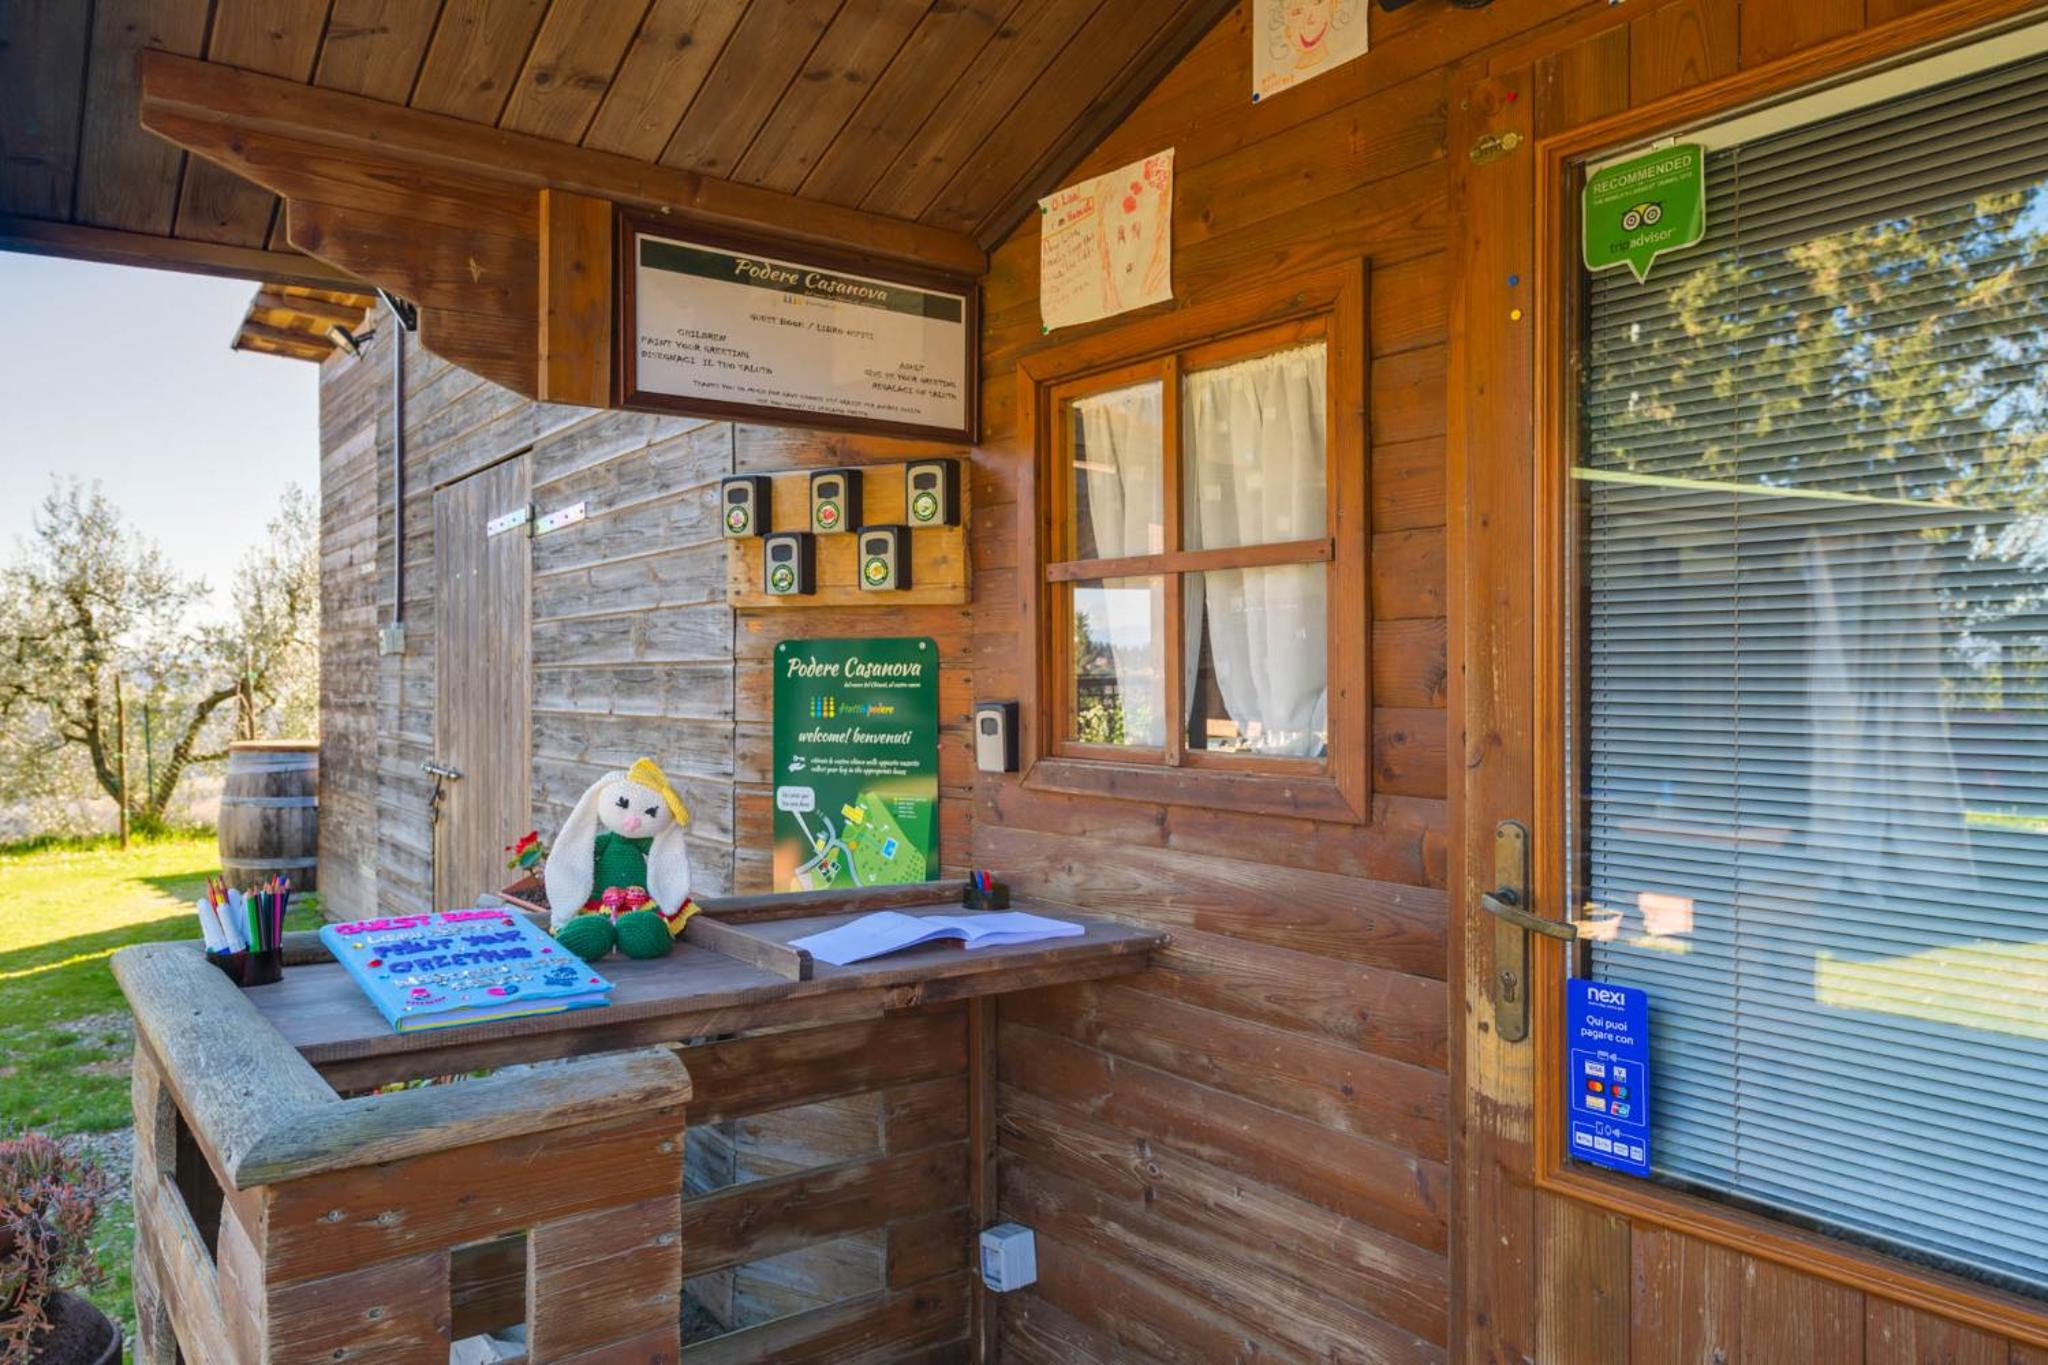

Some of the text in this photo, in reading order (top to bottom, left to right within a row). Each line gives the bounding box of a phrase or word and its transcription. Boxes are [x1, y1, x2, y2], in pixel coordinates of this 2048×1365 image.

[1593, 155, 1692, 195] RECOMMENDED
[1610, 228, 1673, 253] tripadvisor
[734, 258, 798, 285] Podere
[805, 272, 888, 301] Casanova
[780, 317, 803, 328] BOOK
[640, 335, 671, 346] PAINT
[675, 340, 701, 351] YOUR
[677, 328, 727, 342] CHILDREN
[787, 656, 922, 679] Podere Casanova
[798, 726, 912, 745] welcome! benvenuti
[335, 913, 431, 935] GUEST
[1587, 987, 1625, 1006] nexi
[1586, 1015, 1627, 1032] Qui puoi
[1581, 1027, 1634, 1045] pagare con
